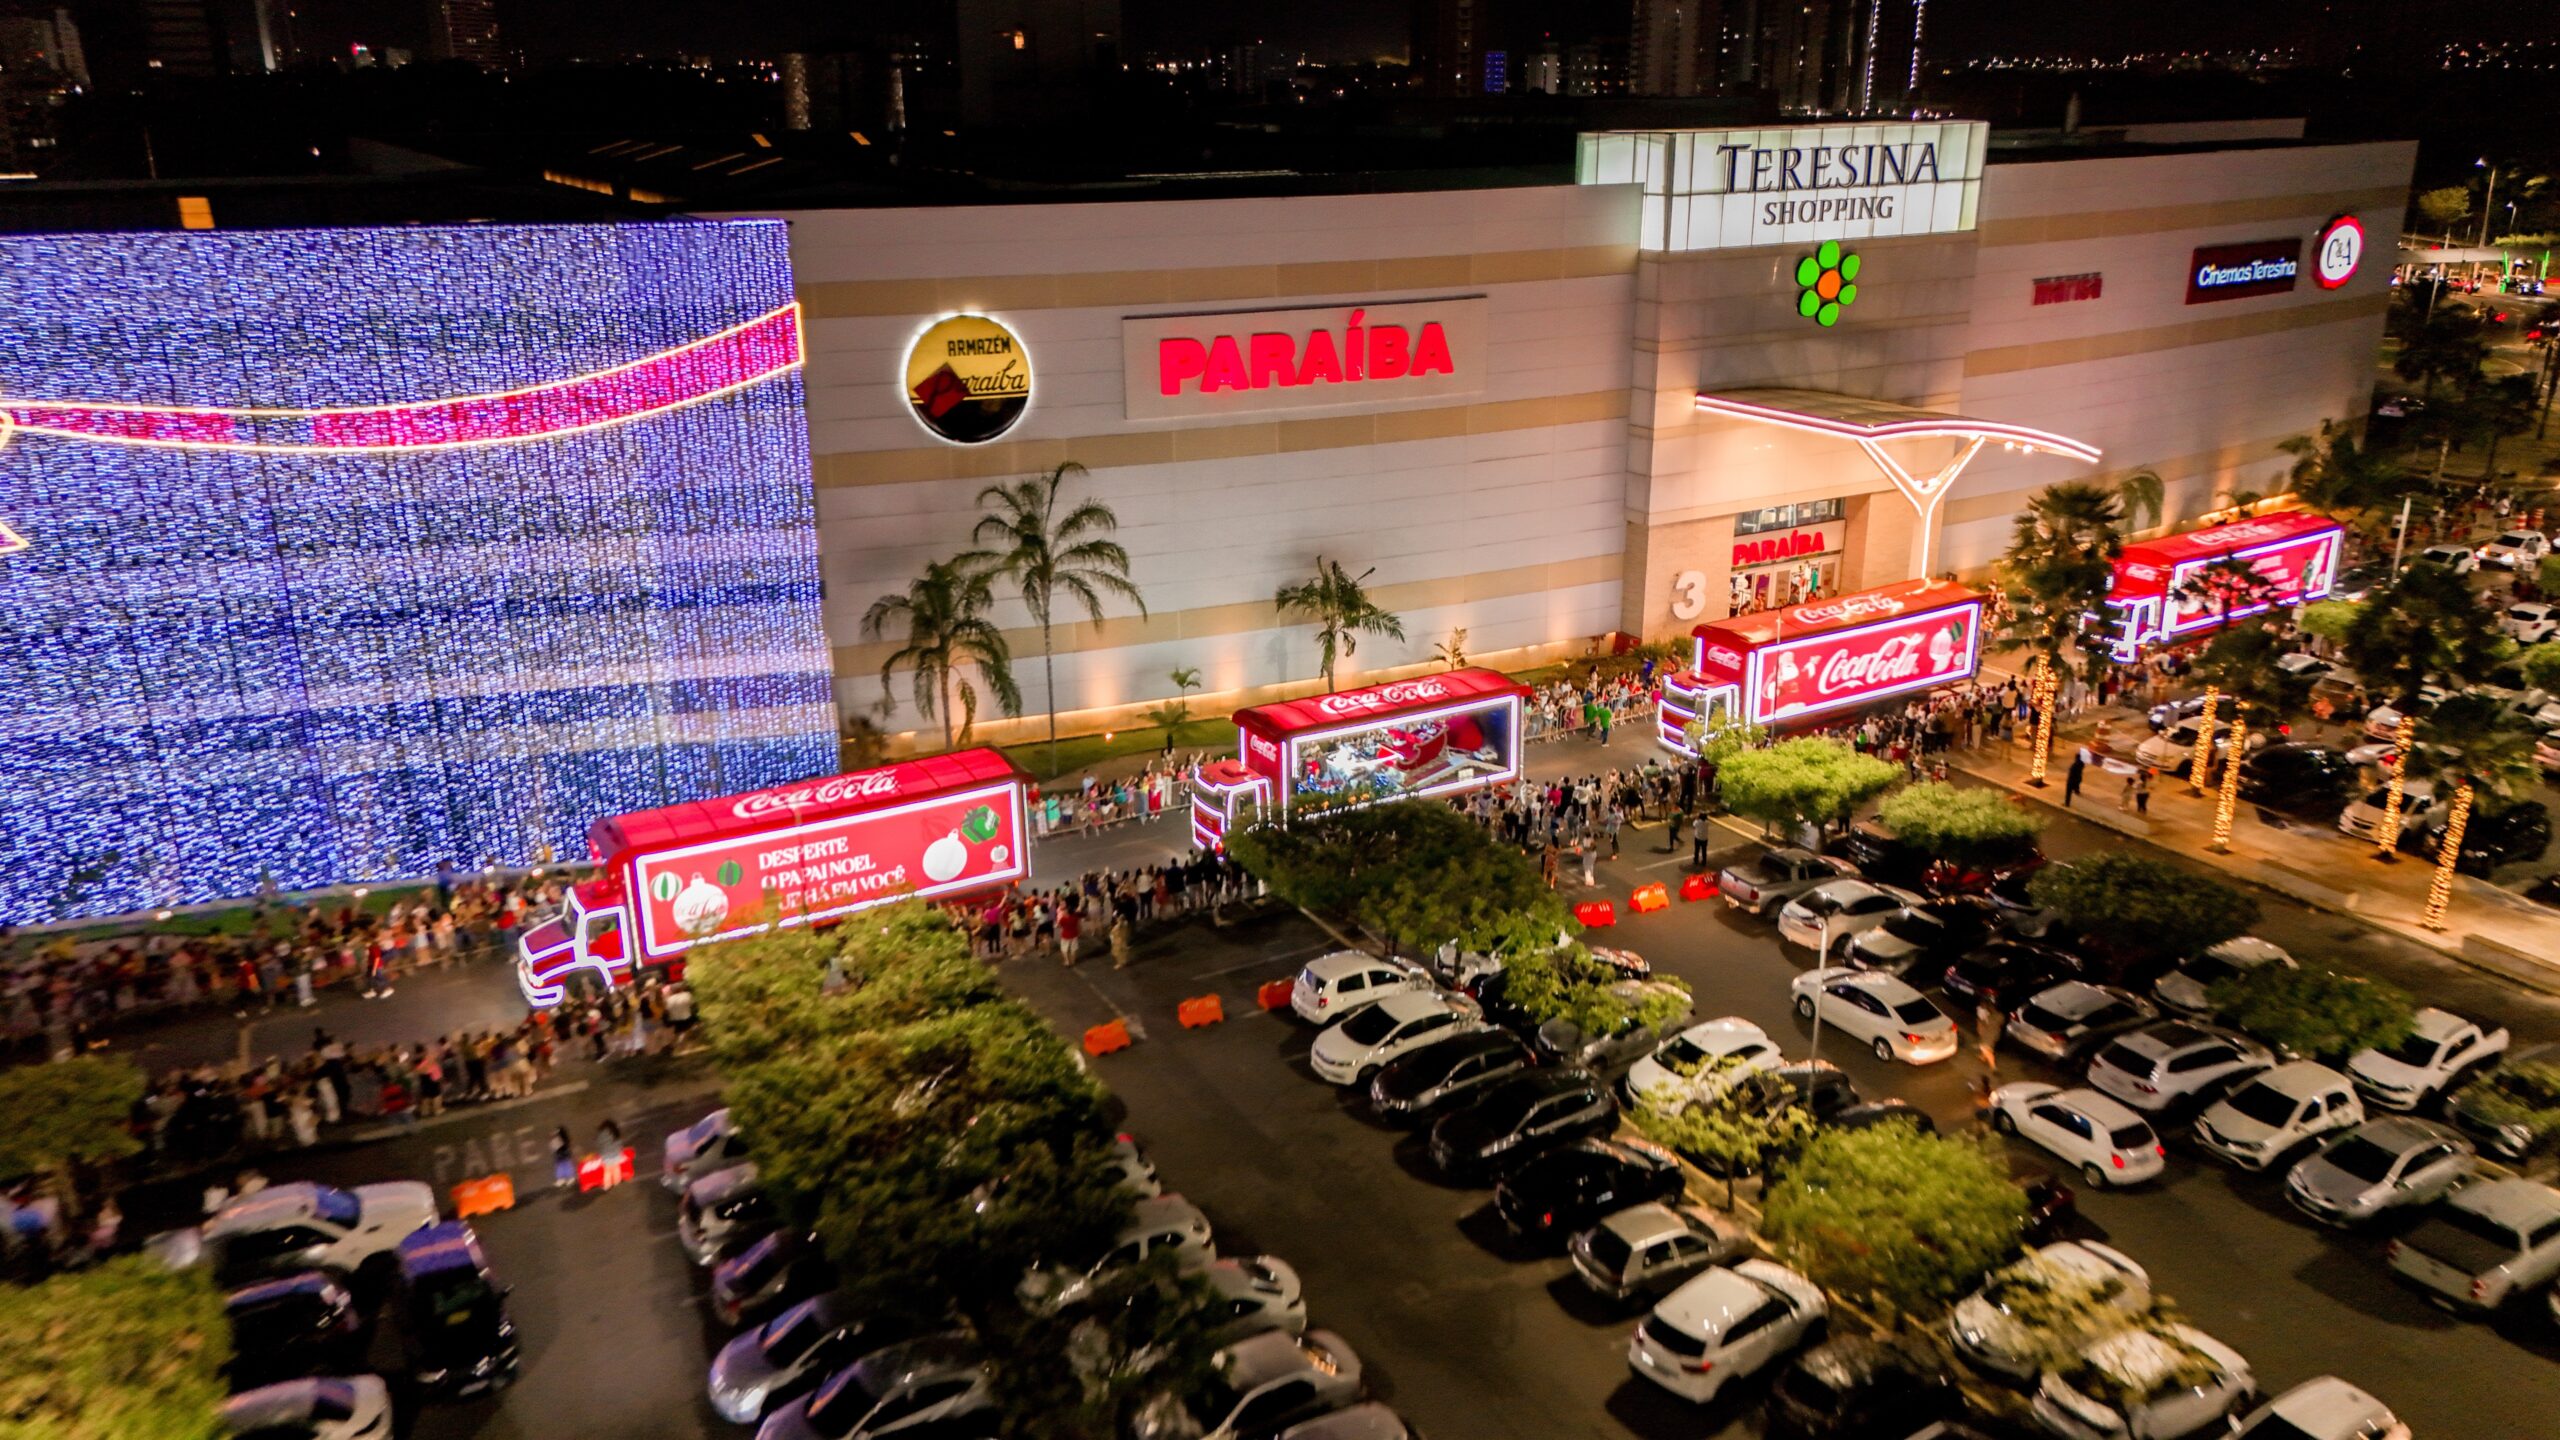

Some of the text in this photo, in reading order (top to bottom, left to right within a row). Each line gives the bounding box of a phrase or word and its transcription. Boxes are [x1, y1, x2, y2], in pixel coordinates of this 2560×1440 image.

[1716, 142, 1939, 193] TERESINA
[1763, 196, 1893, 226] SHOPPING
[2327, 237, 2352, 269] C&A
[2198, 257, 2297, 287] Cinemas Teresina
[947, 335, 1012, 357] ARMAZÉM
[1160, 308, 1454, 395] PARAÍBA
[1732, 529, 1825, 566] PARAÍBA
[1672, 570, 1706, 620] 3
[758, 837, 848, 870] DESPERTE
[778, 862, 828, 889] PAPAI
[829, 854, 876, 879] NOEL
[832, 880, 857, 899] EM
[860, 864, 906, 890] VOCÊ
